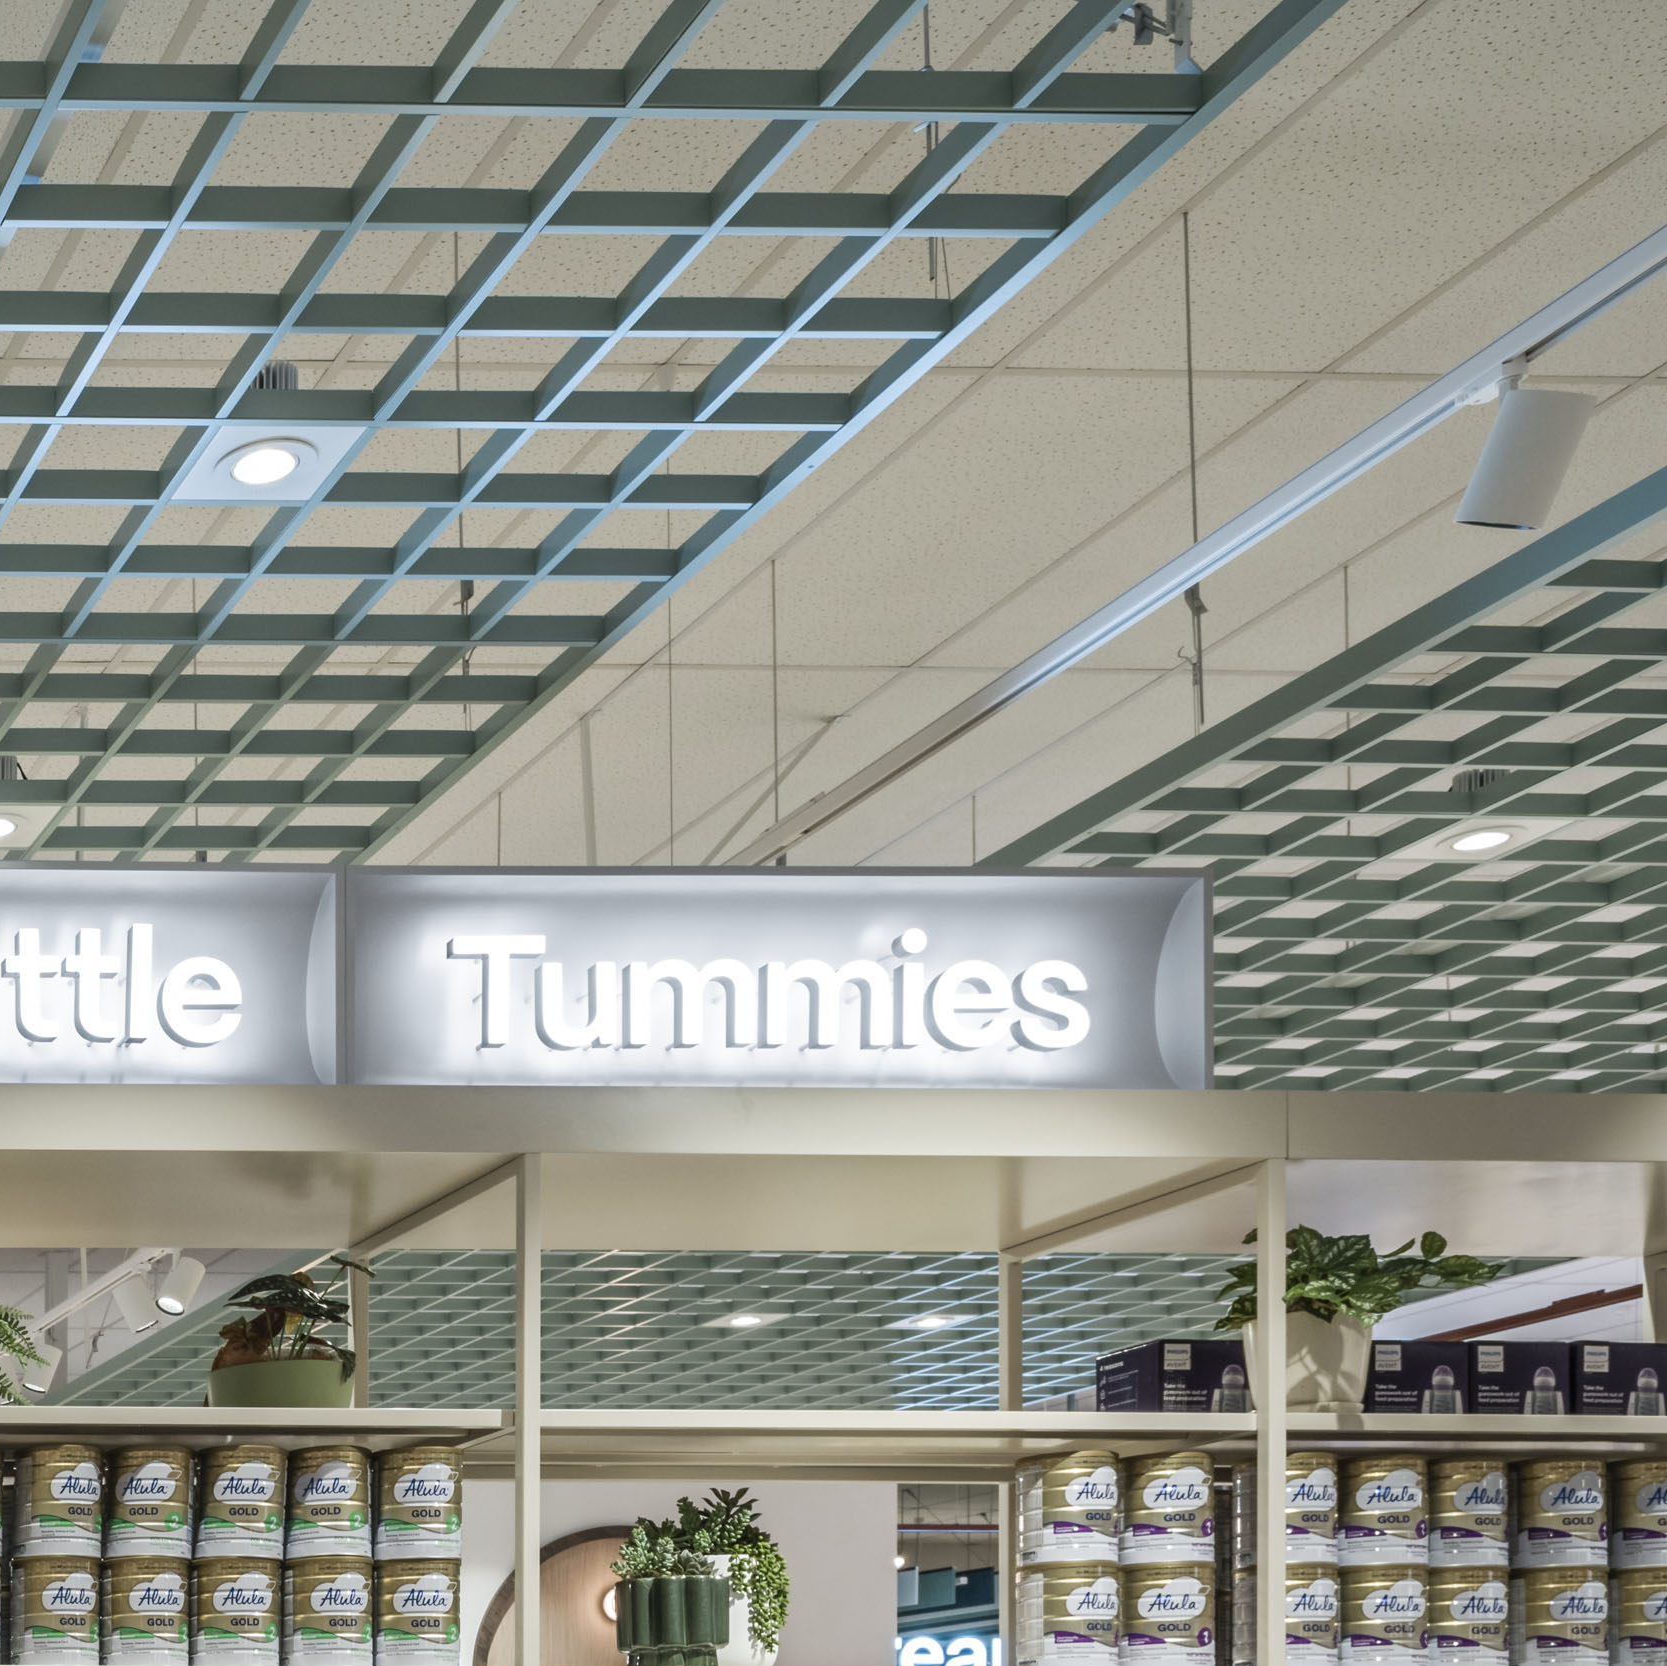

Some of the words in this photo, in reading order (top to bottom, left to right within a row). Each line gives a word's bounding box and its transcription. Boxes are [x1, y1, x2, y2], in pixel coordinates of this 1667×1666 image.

[446, 928, 1091, 1051] Tummies
[222, 1477, 267, 1496] Alula
[403, 1479, 448, 1498] Alula
[1154, 1483, 1203, 1502] Alula
[229, 1507, 259, 1516] GOLD
[411, 1509, 441, 1518] GOLD
[1164, 1513, 1195, 1521] GOLD
[402, 1589, 447, 1608] Alula
[1148, 1594, 1198, 1612] Alula
[411, 1618, 440, 1628] GOLD
[1158, 1623, 1190, 1632] GOLD
